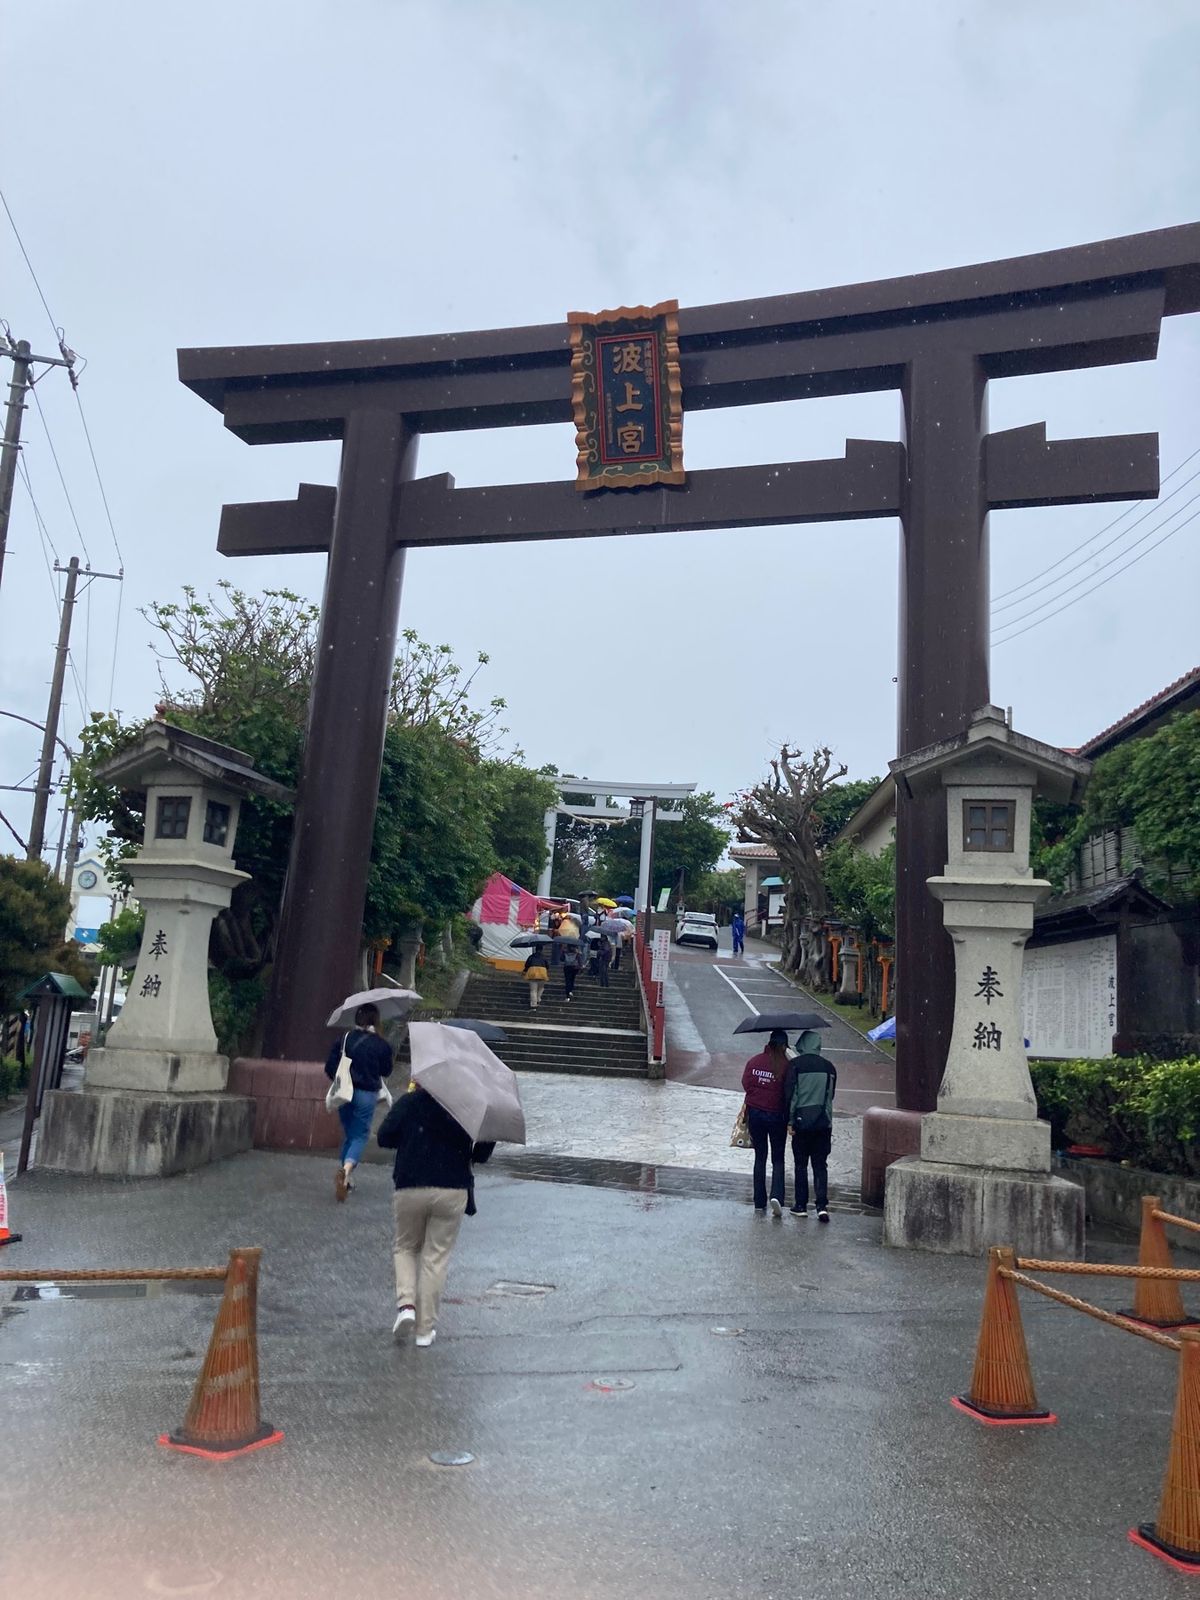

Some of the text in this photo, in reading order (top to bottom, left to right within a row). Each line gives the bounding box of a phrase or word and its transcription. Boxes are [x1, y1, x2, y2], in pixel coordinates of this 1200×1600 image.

[612, 342, 645, 454] 波上宮
[139, 929, 168, 998] 奉納
[972, 965, 1004, 1052] 奉納
[1107, 974, 1116, 1027] 波上宮
[752, 1068, 775, 1080] tomm
